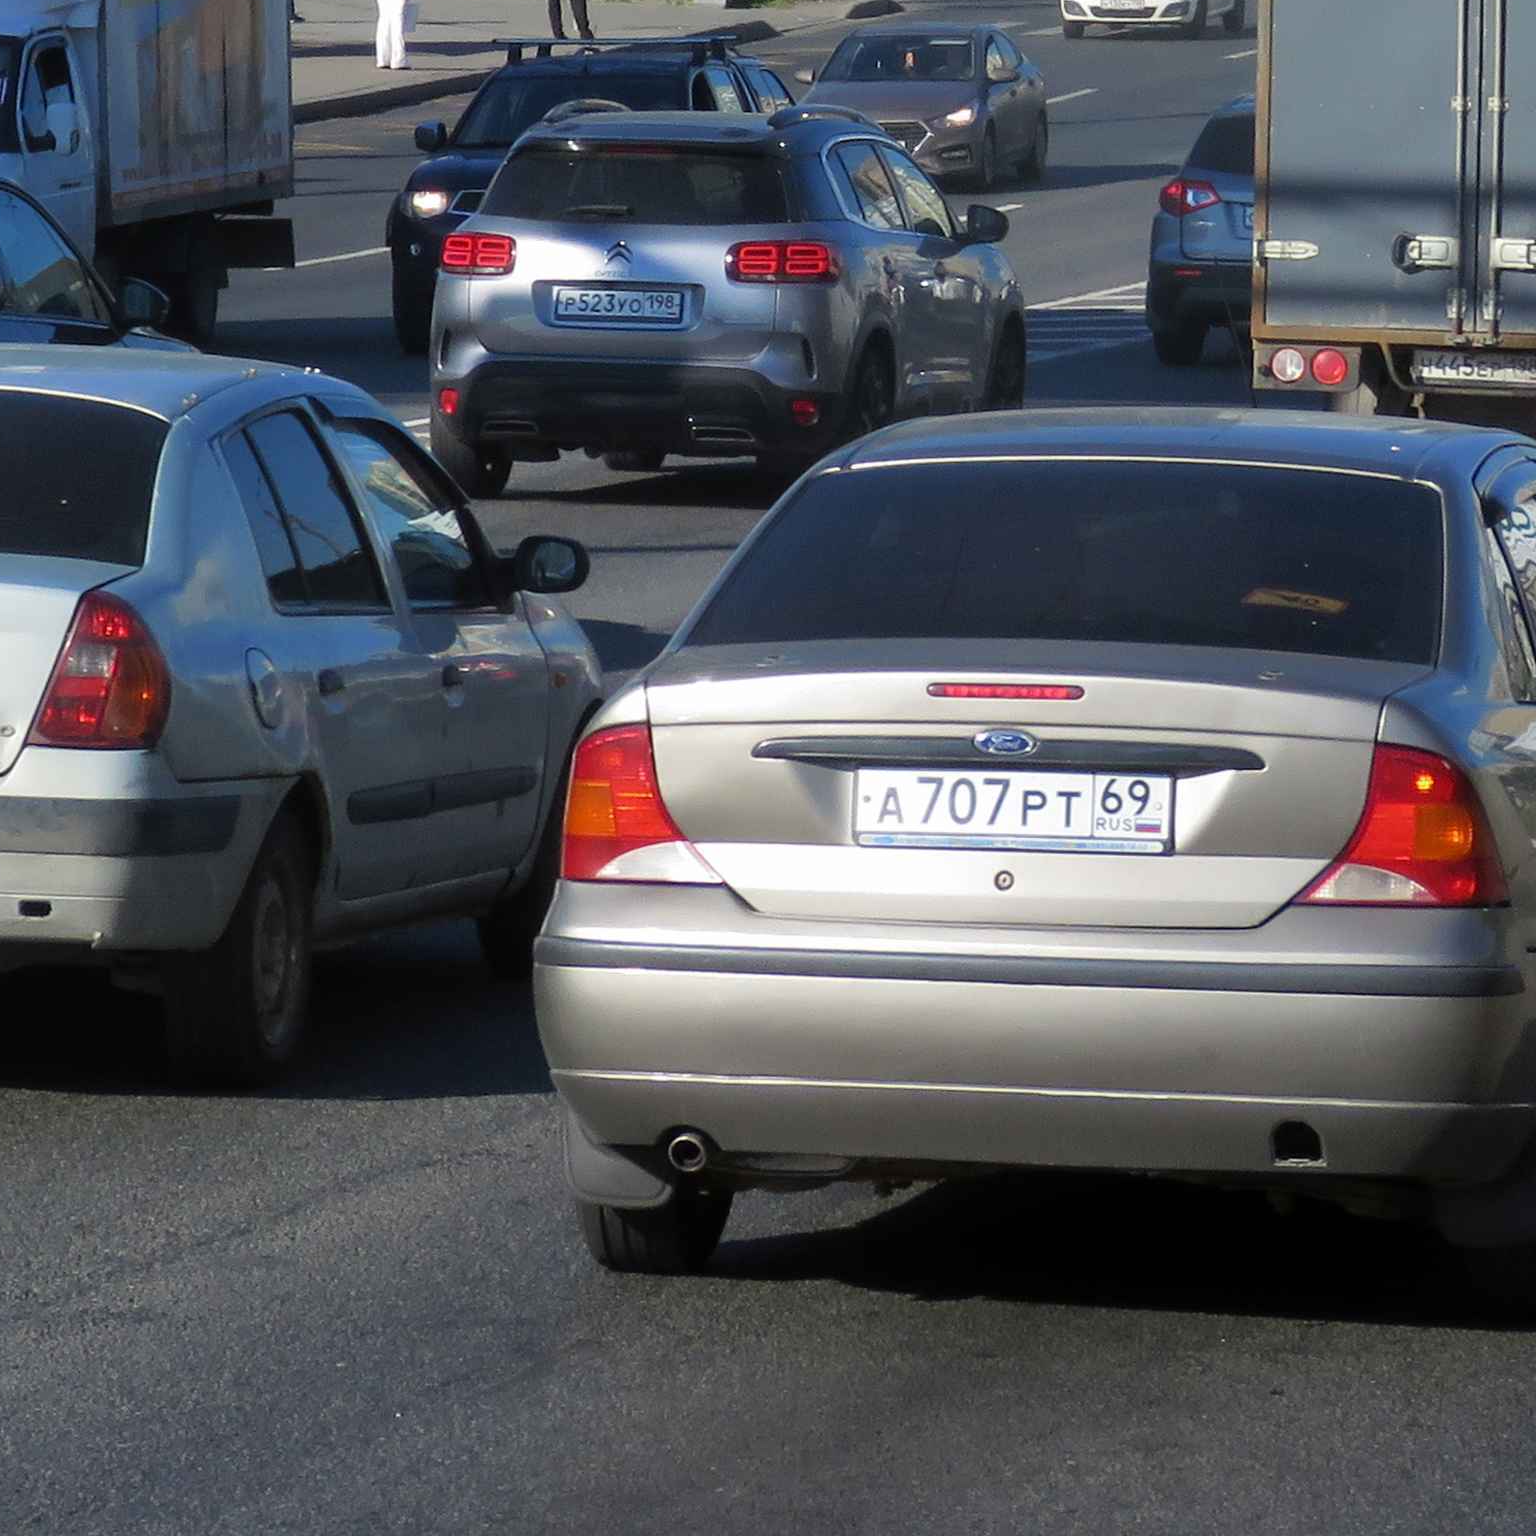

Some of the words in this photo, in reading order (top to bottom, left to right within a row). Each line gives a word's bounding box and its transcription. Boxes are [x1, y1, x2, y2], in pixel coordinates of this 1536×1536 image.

[565, 294, 642, 313] Р523УО
[646, 295, 674, 309] 198
[877, 777, 1081, 828] А707РТ
[1100, 779, 1150, 815] 69
[1095, 817, 1133, 832] RUS
